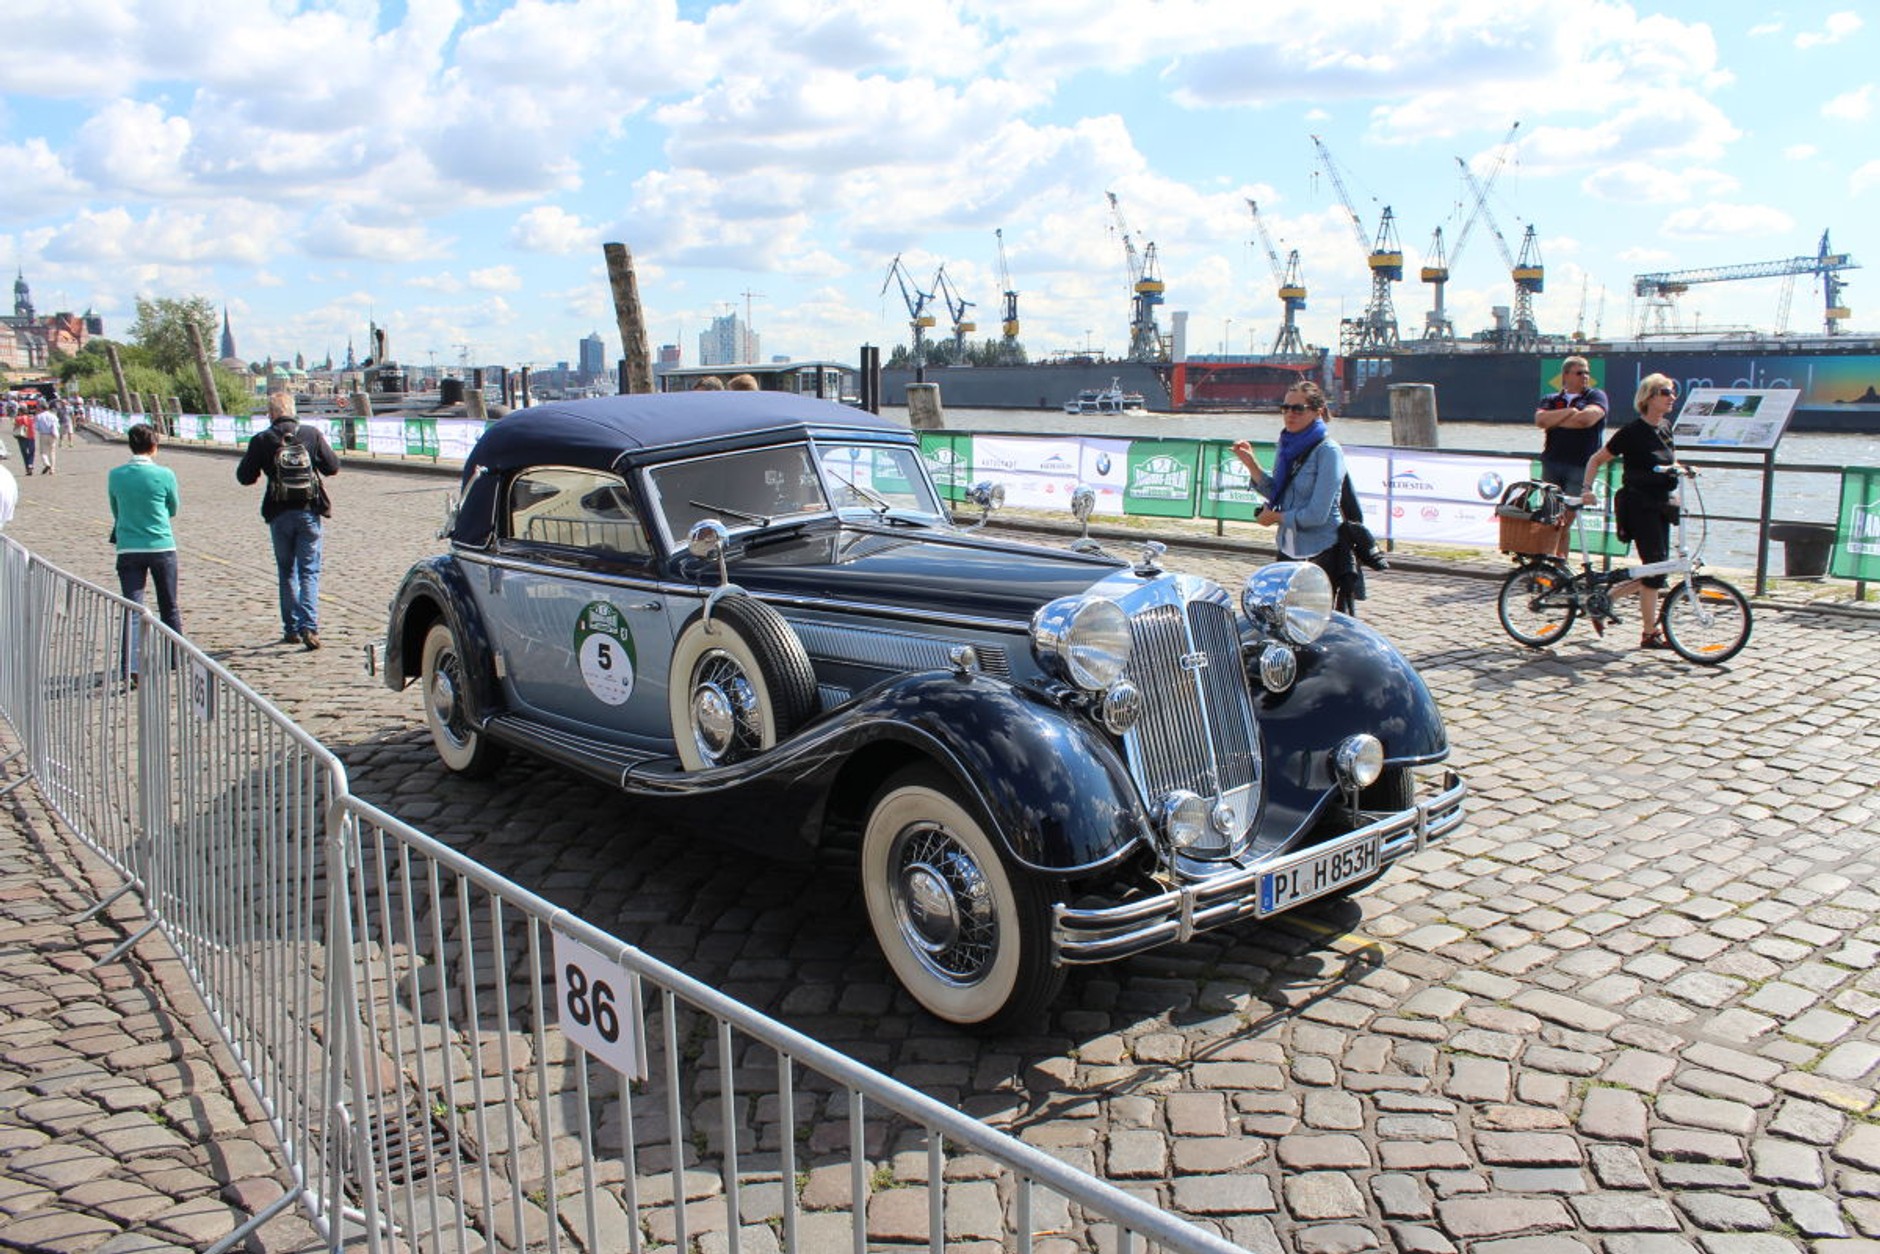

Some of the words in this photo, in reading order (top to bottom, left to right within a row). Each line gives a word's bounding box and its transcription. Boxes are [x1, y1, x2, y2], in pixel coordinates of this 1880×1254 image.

[598, 643, 612, 670] 5
[1275, 870, 1300, 904] PI
[565, 963, 619, 1043] 86
